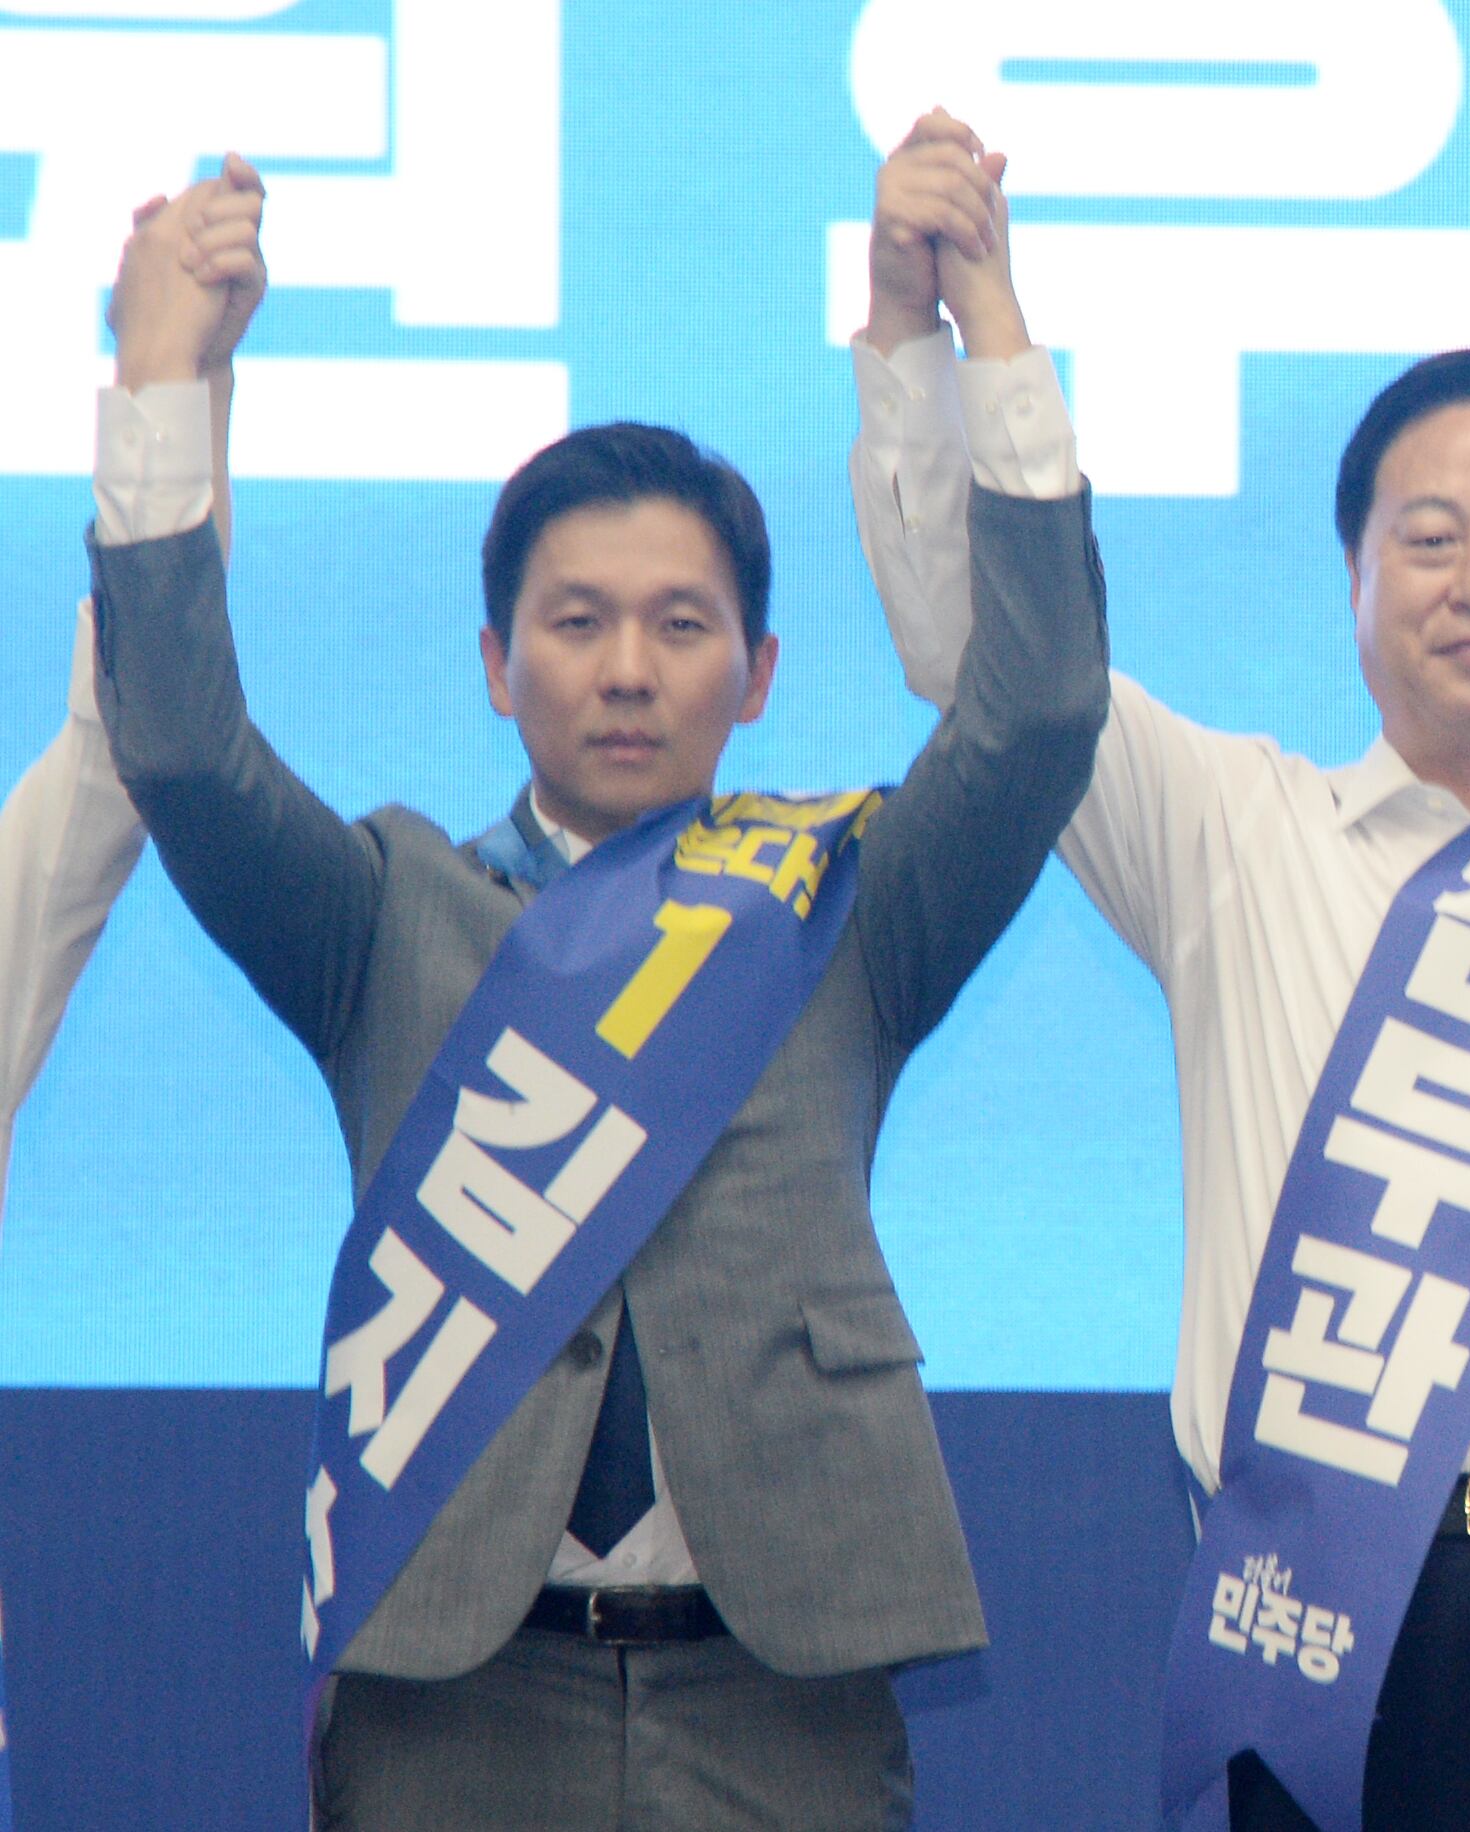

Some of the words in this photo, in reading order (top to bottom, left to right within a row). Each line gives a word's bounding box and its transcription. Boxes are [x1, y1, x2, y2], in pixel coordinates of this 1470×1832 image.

[594, 897, 733, 1060] 1
[300, 1024, 649, 1664] 김지
[1207, 1571, 1356, 1686] 민주당
